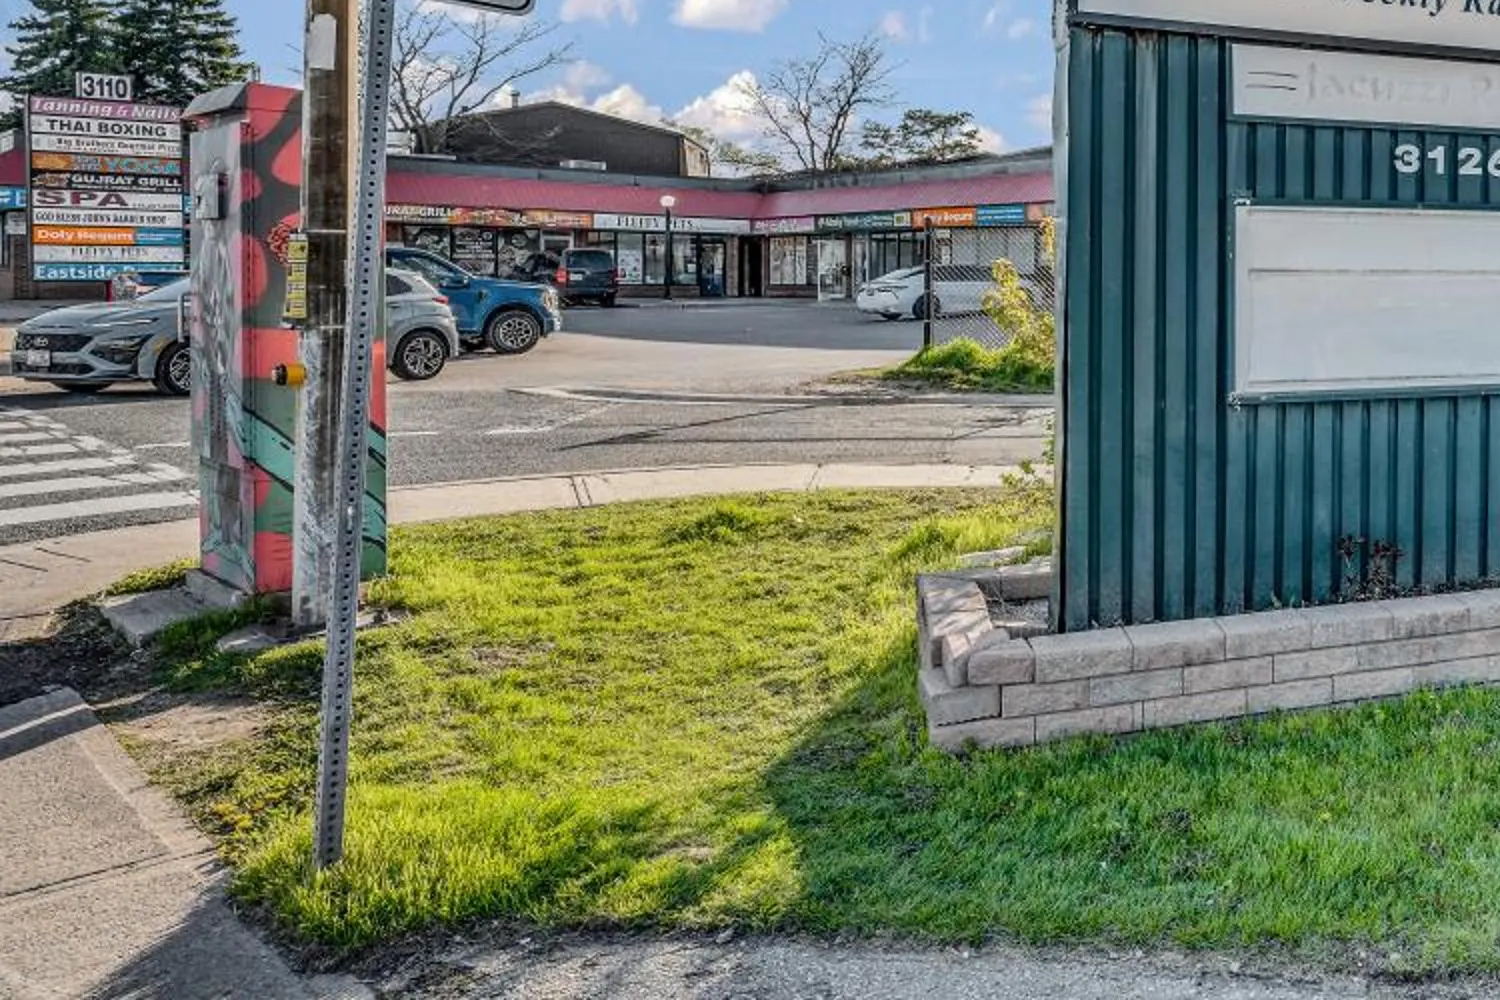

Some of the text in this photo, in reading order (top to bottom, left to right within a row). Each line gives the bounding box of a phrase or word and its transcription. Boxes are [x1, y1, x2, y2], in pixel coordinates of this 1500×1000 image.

[83, 76, 128, 98] 3110
[32, 99, 113, 117] Tanning
[46, 118, 168, 137] THAI BOXING
[71, 173, 182, 188] GUJRAT GRILL
[36, 190, 129, 206] SPA
[37, 229, 74, 242] Doly
[36, 263, 116, 281] Eastside
